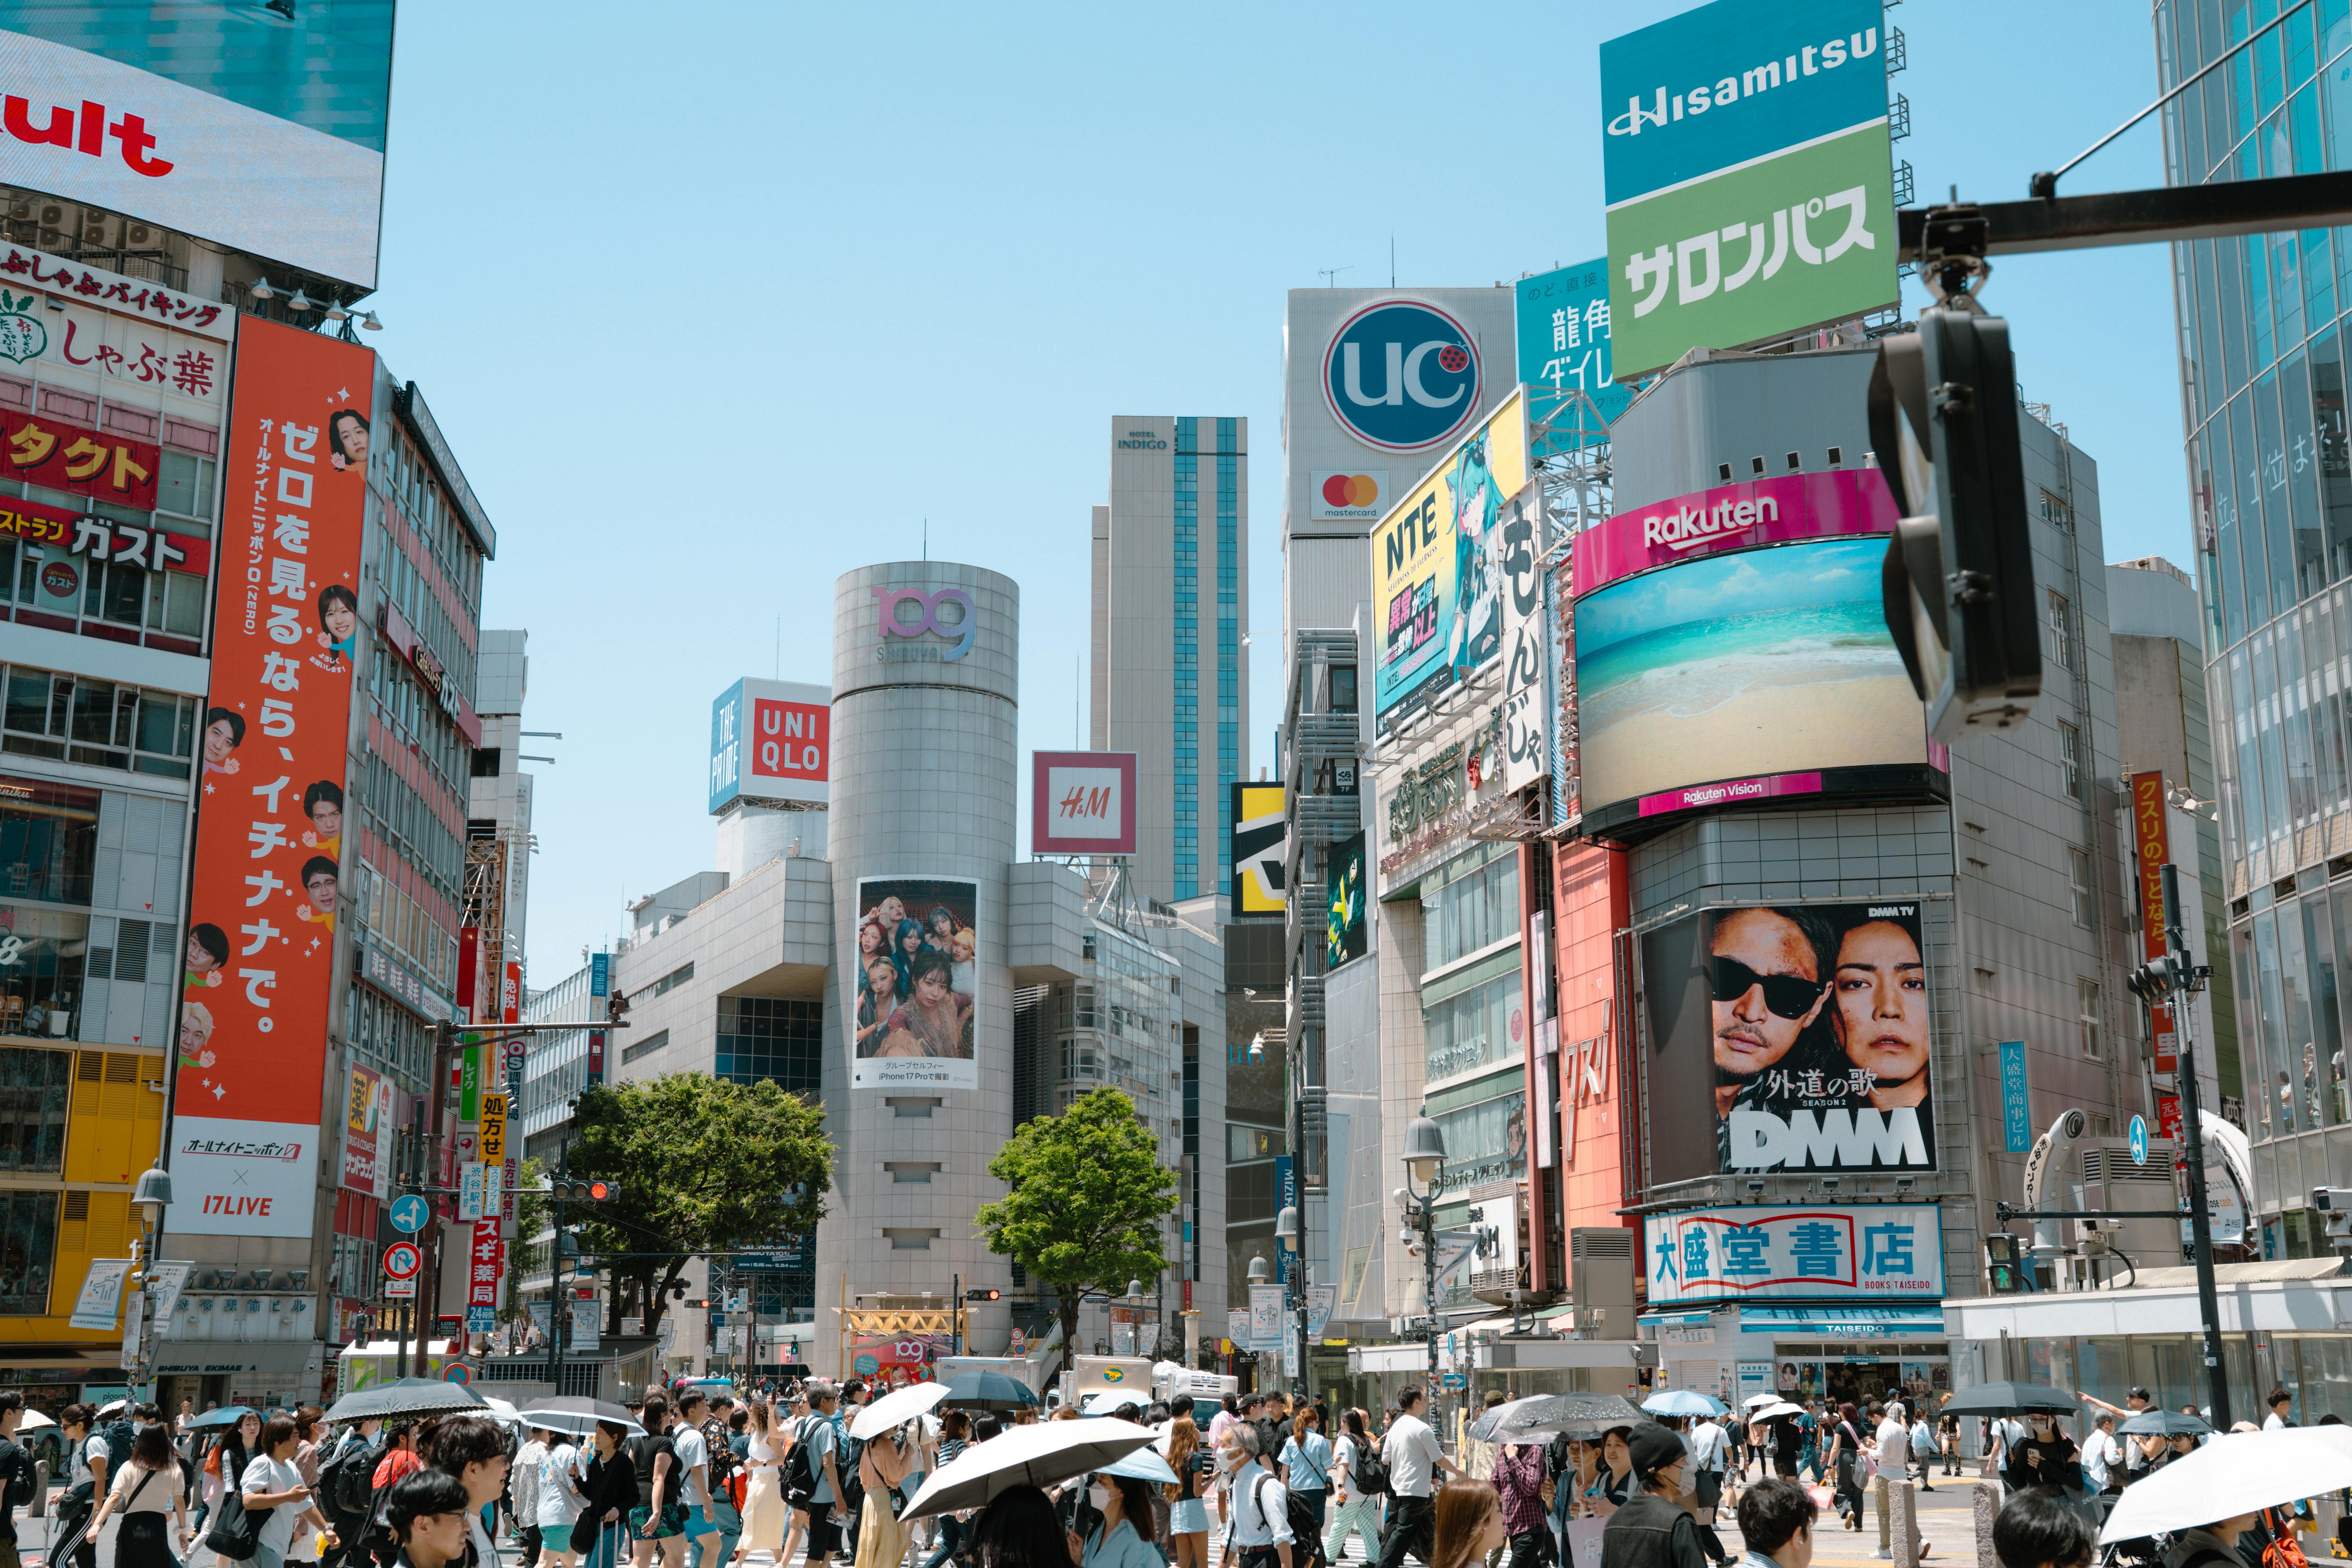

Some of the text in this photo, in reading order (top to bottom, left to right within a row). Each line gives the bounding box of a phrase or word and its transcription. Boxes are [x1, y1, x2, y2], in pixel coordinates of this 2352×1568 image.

[1607, 27, 1877, 136] Hisamitsu
[0, 93, 174, 177] ult
[1625, 185, 1875, 319] サロンパス
[0, 250, 221, 327] ぶしゃぶバイキング
[64, 319, 214, 397] しゃぶ葉
[10, 423, 148, 488] タクト
[1118, 440, 1167, 450] INDIGO
[1387, 490, 1437, 581] NTE
[1644, 496, 1778, 550] Rakuten
[70, 517, 185, 572] ガスト
[46, 576, 75, 589] ガスト
[1388, 544, 1438, 593] NEVERNESS TO EVERNESS
[871, 587, 976, 661] 109
[1504, 500, 1542, 773] もんじゃ
[319, 653, 340, 663] よろしく
[877, 647, 937, 661] SHIBUYA
[440, 672, 460, 723] ガスト
[720, 700, 734, 749] THE
[763, 709, 816, 740] UNI
[712, 740, 738, 797] PRIME
[762, 742, 820, 772] QLO
[1060, 787, 1111, 820] H&M
[1684, 782, 1762, 805] Rakuten Vision
[1869, 906, 1914, 917] DMM TV
[372, 952, 419, 1005] 薄毛 抜毛 発毛
[505, 978, 516, 1009] 免税
[594, 960, 605, 994] THE PRIME
[465, 1062, 477, 1090] レイク
[879, 1072, 905, 1080] iPhone
[886, 1062, 944, 1070] グループセルフィー
[1766, 1067, 1882, 1099] 外道の歌
[351, 1076, 365, 1126] 薬
[1801, 1099, 1837, 1108] SEASON
[2006, 1048, 2026, 1147] 大盛堂商事ビル
[348, 1134, 376, 1154] DRUG & COSMETIC
[1729, 1107, 1929, 1168] DMM
[346, 1152, 375, 1180] サンドラッグ
[203, 1195, 273, 1216] 17LIVE
[470, 1167, 481, 1215] 渋谷駅前
[489, 1168, 499, 1214] スクランブル式
[473, 1220, 498, 1303] スギ薬局
[1656, 1222, 1914, 1283] 大盛堂書店
[1894, 1281, 1930, 1289] TAISEIDO
[177, 1299, 306, 1312] 渋谷駅前ビル
[1661, 1316, 1685, 1324] TAISEIDO
[469, 1321, 494, 1332] 営業
[1285, 1316, 1294, 1366] 文化村通り
[894, 1341, 923, 1363] 109
